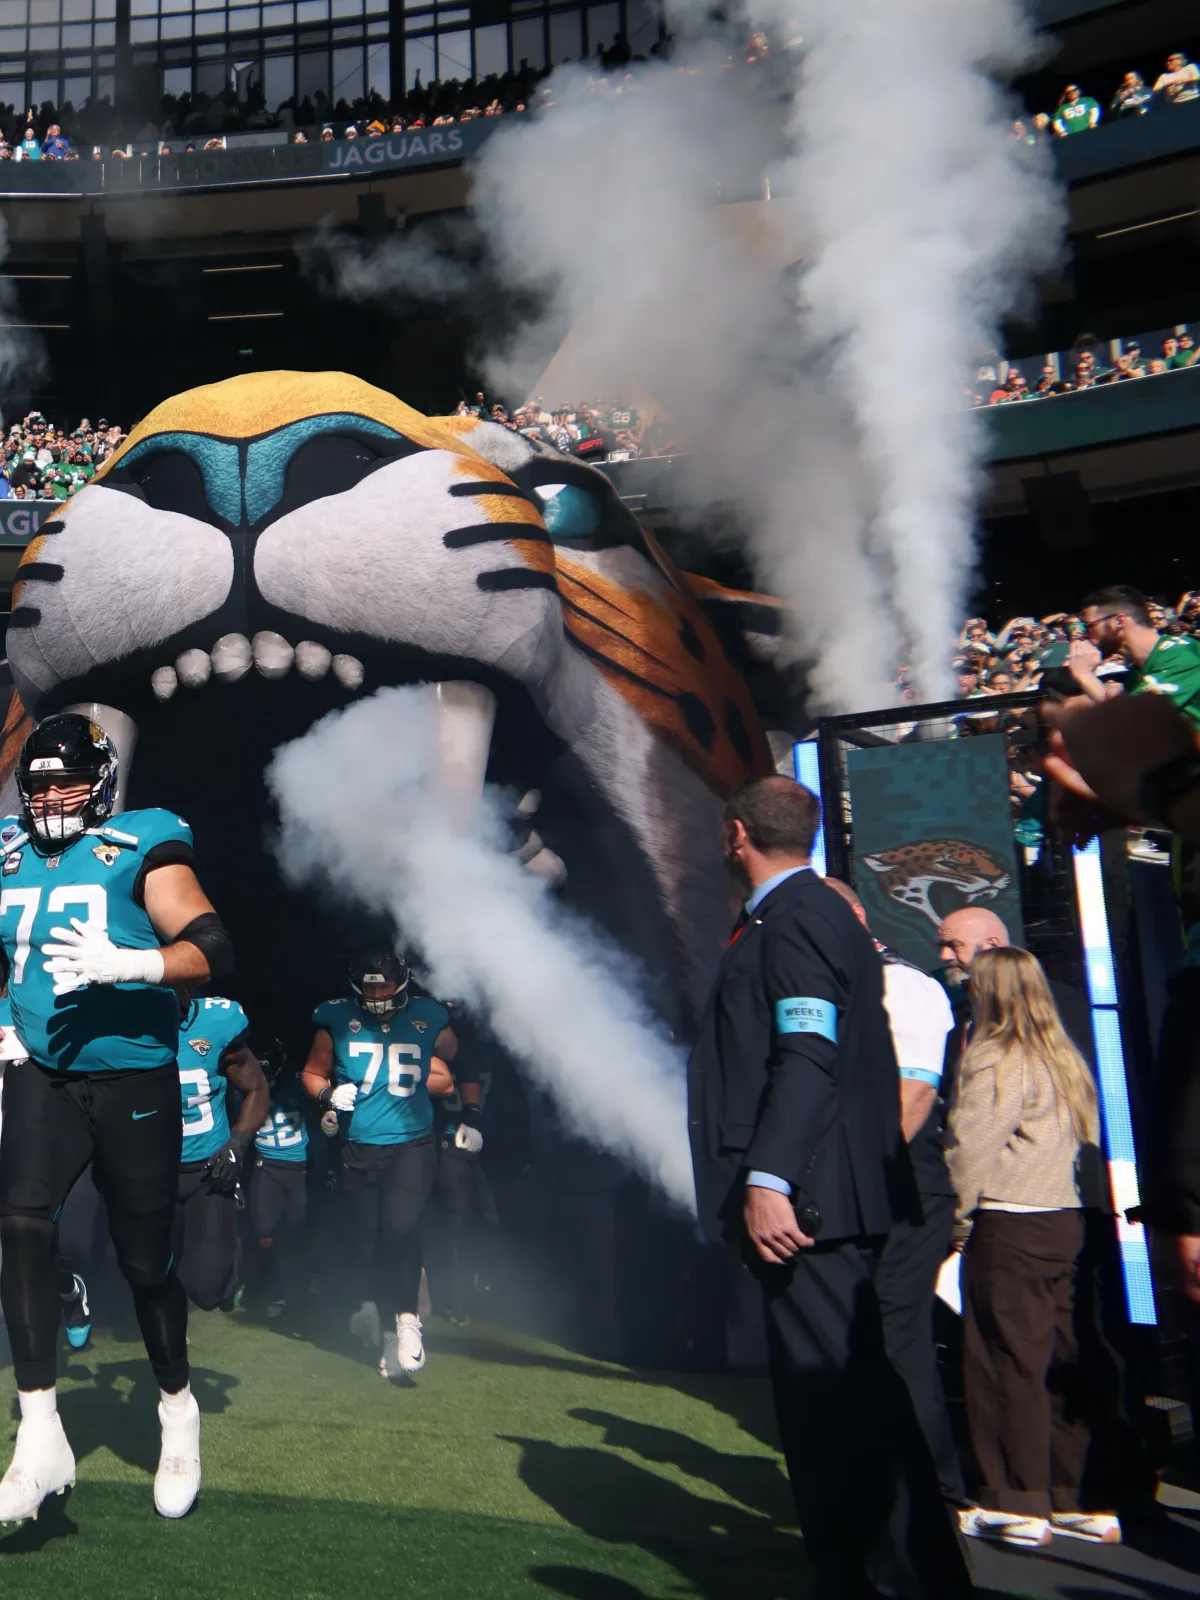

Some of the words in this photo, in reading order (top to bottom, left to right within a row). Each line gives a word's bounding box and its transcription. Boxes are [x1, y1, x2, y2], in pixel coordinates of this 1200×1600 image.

[329, 129, 463, 168] JAGUARS
[578, 438, 603, 451] ESPN
[38, 760, 52, 770] JAX
[785, 1007, 814, 1017] WEEK
[816, 1009, 823, 1018] 5
[349, 1042, 422, 1098] 76
